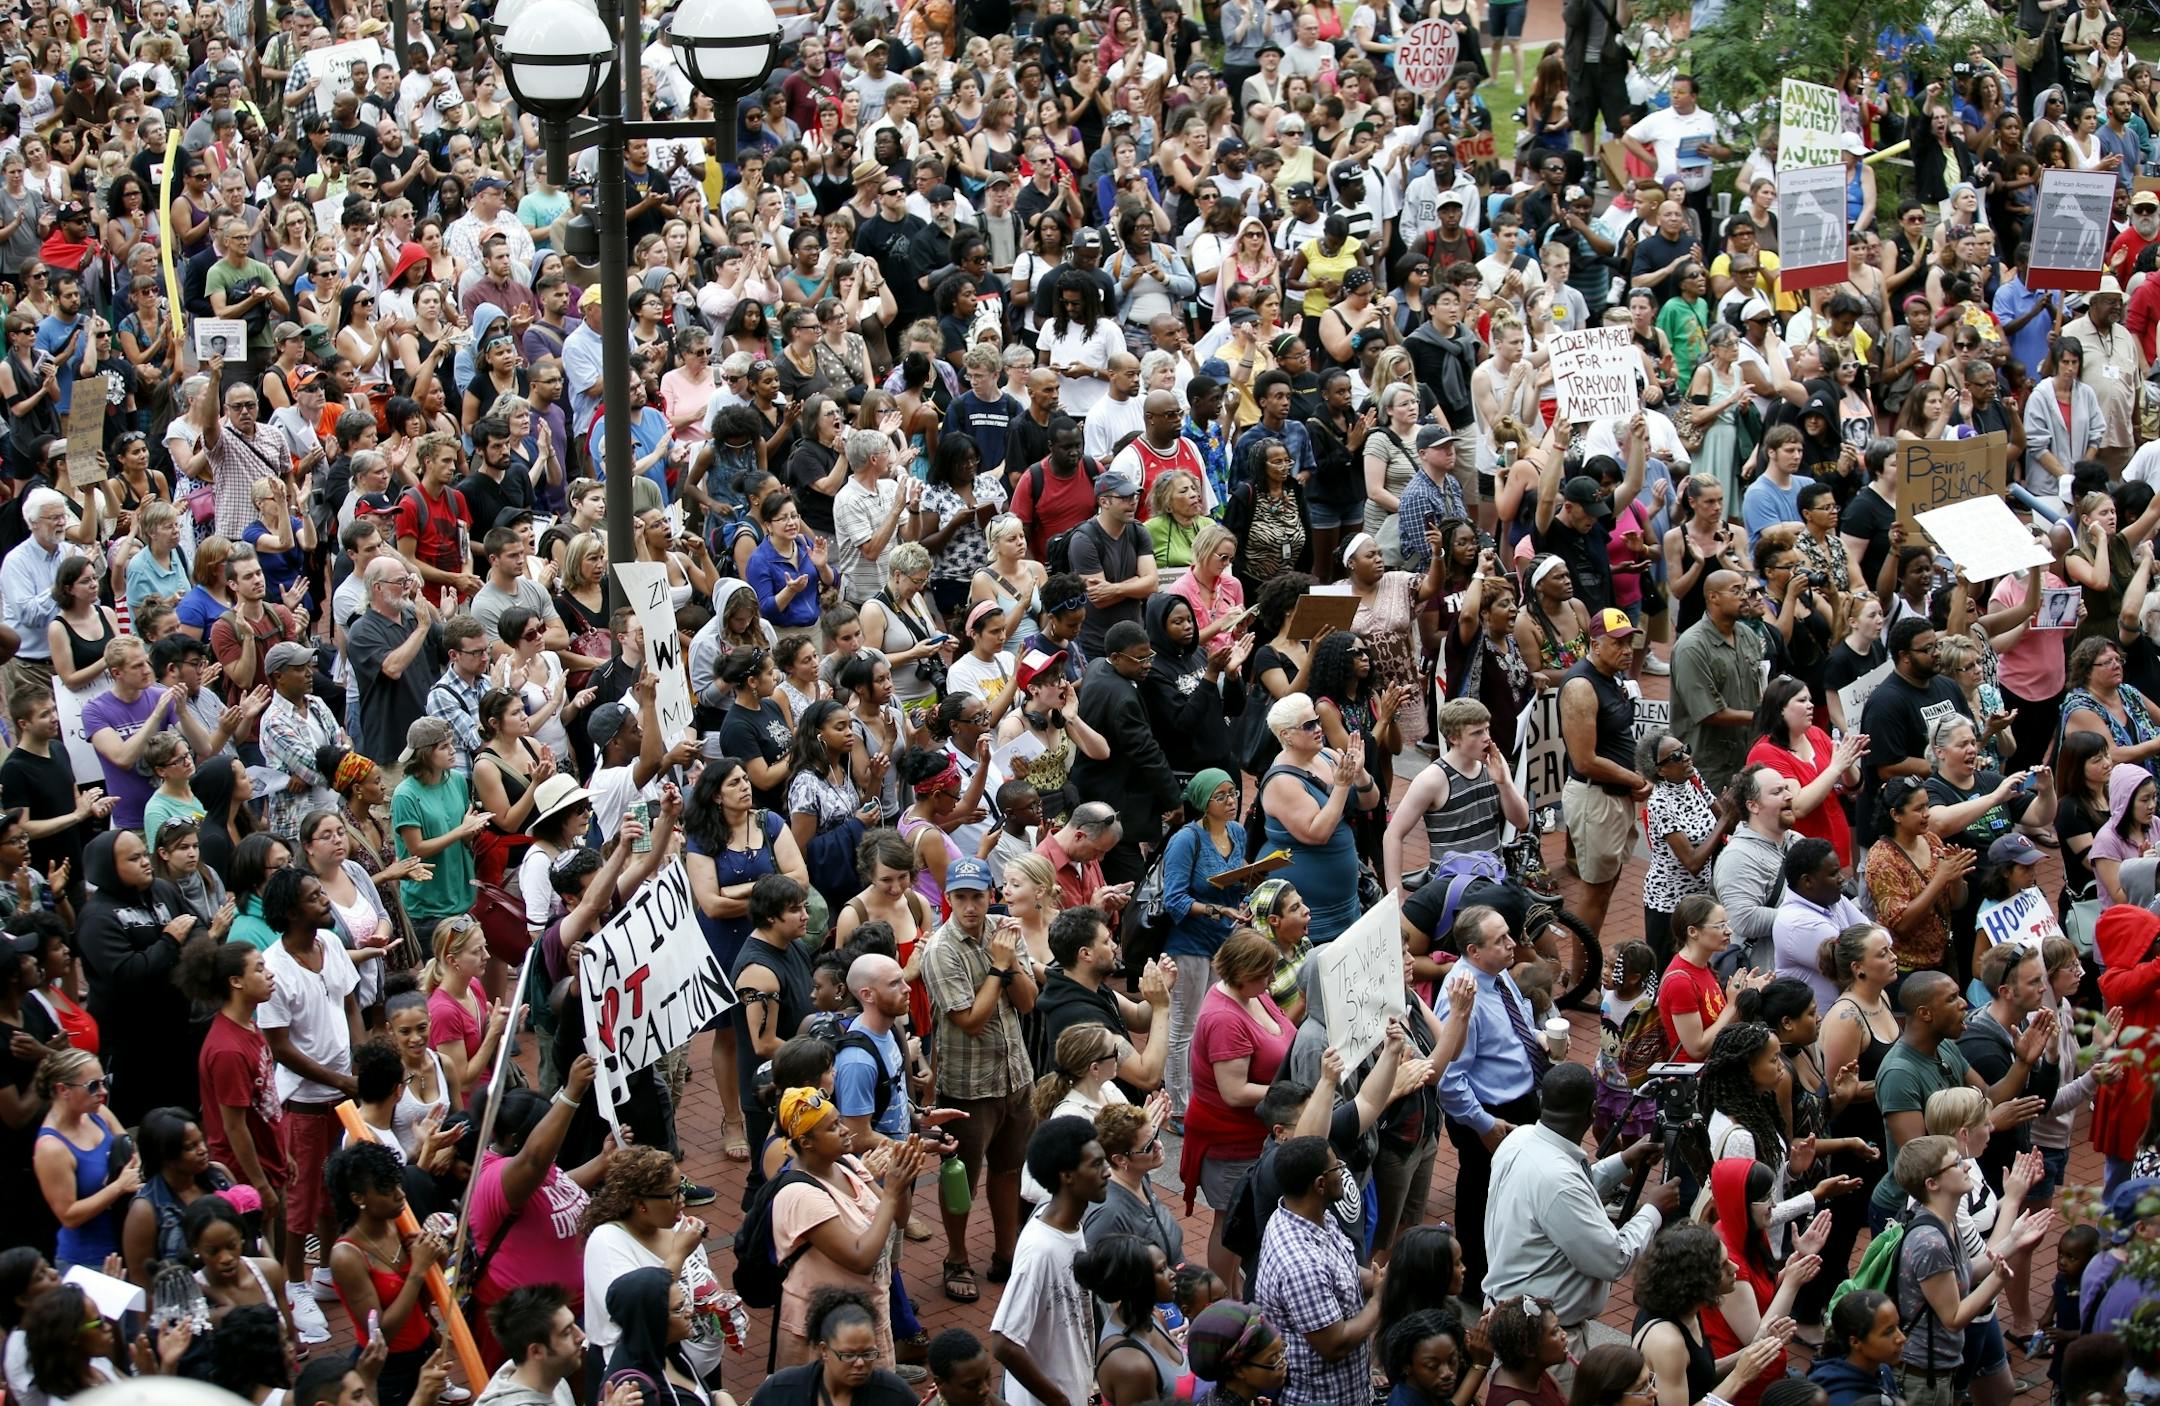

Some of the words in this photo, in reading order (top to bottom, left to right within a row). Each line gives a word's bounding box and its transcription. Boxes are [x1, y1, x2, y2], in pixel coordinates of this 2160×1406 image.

[1409, 23, 1452, 46] STOP
[1399, 46, 1456, 66] RACISM
[1405, 67, 1450, 87] NOW
[1783, 83, 1838, 115] ADJUST
[1783, 107, 1839, 135] SOCIETY
[1455, 135, 1495, 163] STICE
[1794, 146, 1839, 166] JUST
[2053, 180, 2074, 188] African
[2075, 181, 2104, 190] American
[1419, 200, 1436, 221] R
[1551, 335, 1586, 356] IDLE
[1576, 354, 1601, 369] FOR
[1558, 371, 1627, 396] TRAYVON
[1906, 445, 1966, 484] Being
[1931, 470, 1993, 504] BLACK
[1443, 590, 1467, 614] TH
[1527, 692, 1562, 750] ST
[1922, 701, 1954, 717] WARNING
[1527, 750, 1568, 799] EA
[1330, 954, 1359, 998] The
[1355, 927, 1388, 973] Whole
[1345, 973, 1385, 1022] System
[617, 955, 736, 1074] RATION
